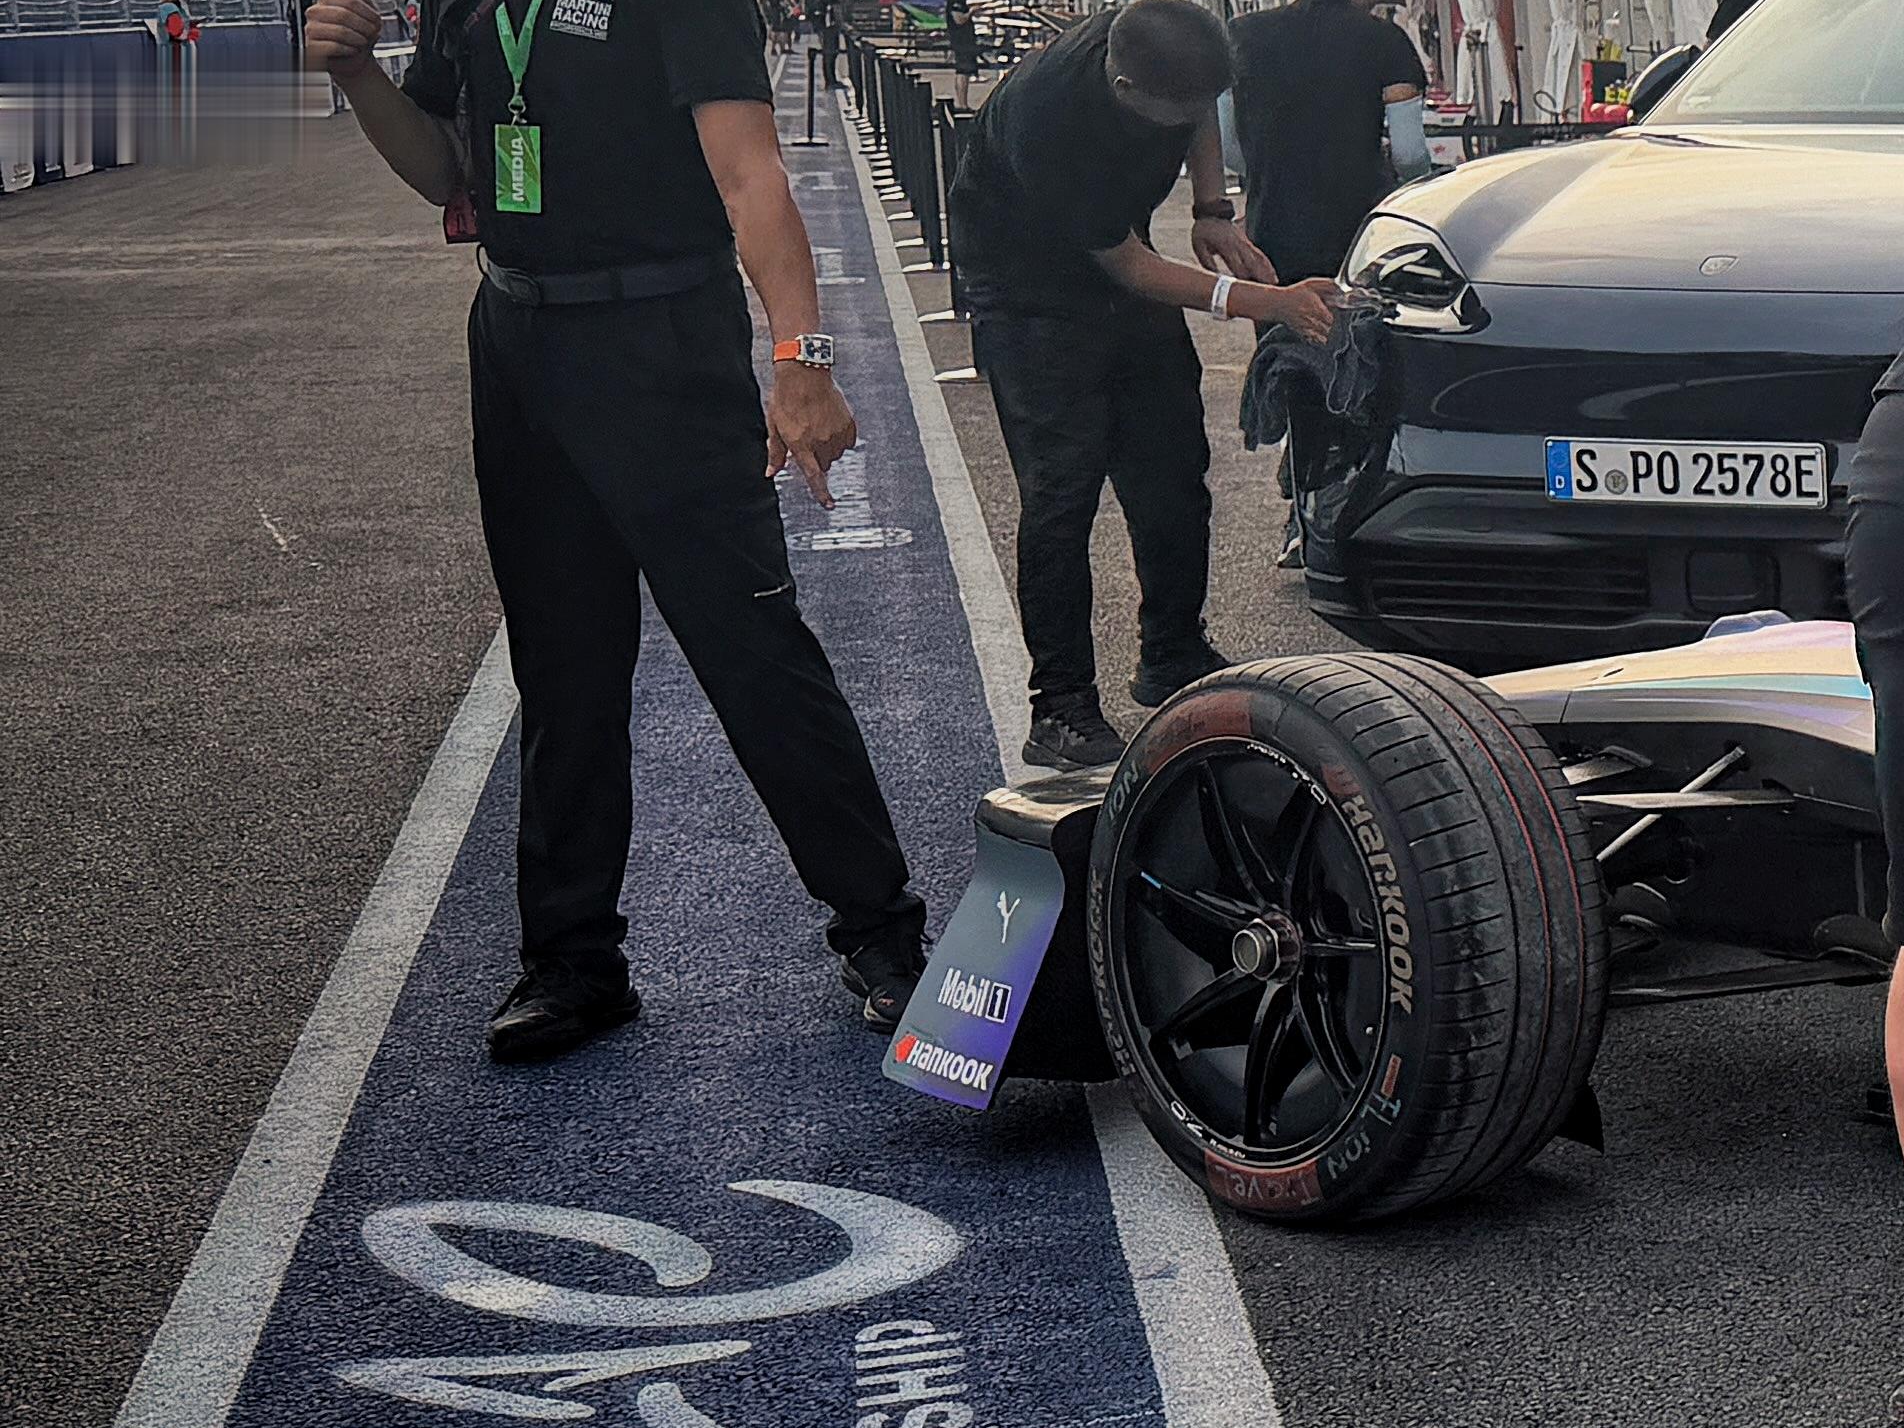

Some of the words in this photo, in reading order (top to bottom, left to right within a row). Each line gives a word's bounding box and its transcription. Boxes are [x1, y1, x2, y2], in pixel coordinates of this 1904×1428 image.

[552, 6, 610, 31] RACING
[511, 136, 525, 203] MEDIA
[1576, 447, 1598, 493] S
[1630, 450, 1681, 496] PO
[1691, 452, 1821, 499] 2578E
[937, 967, 991, 1018] Mobil
